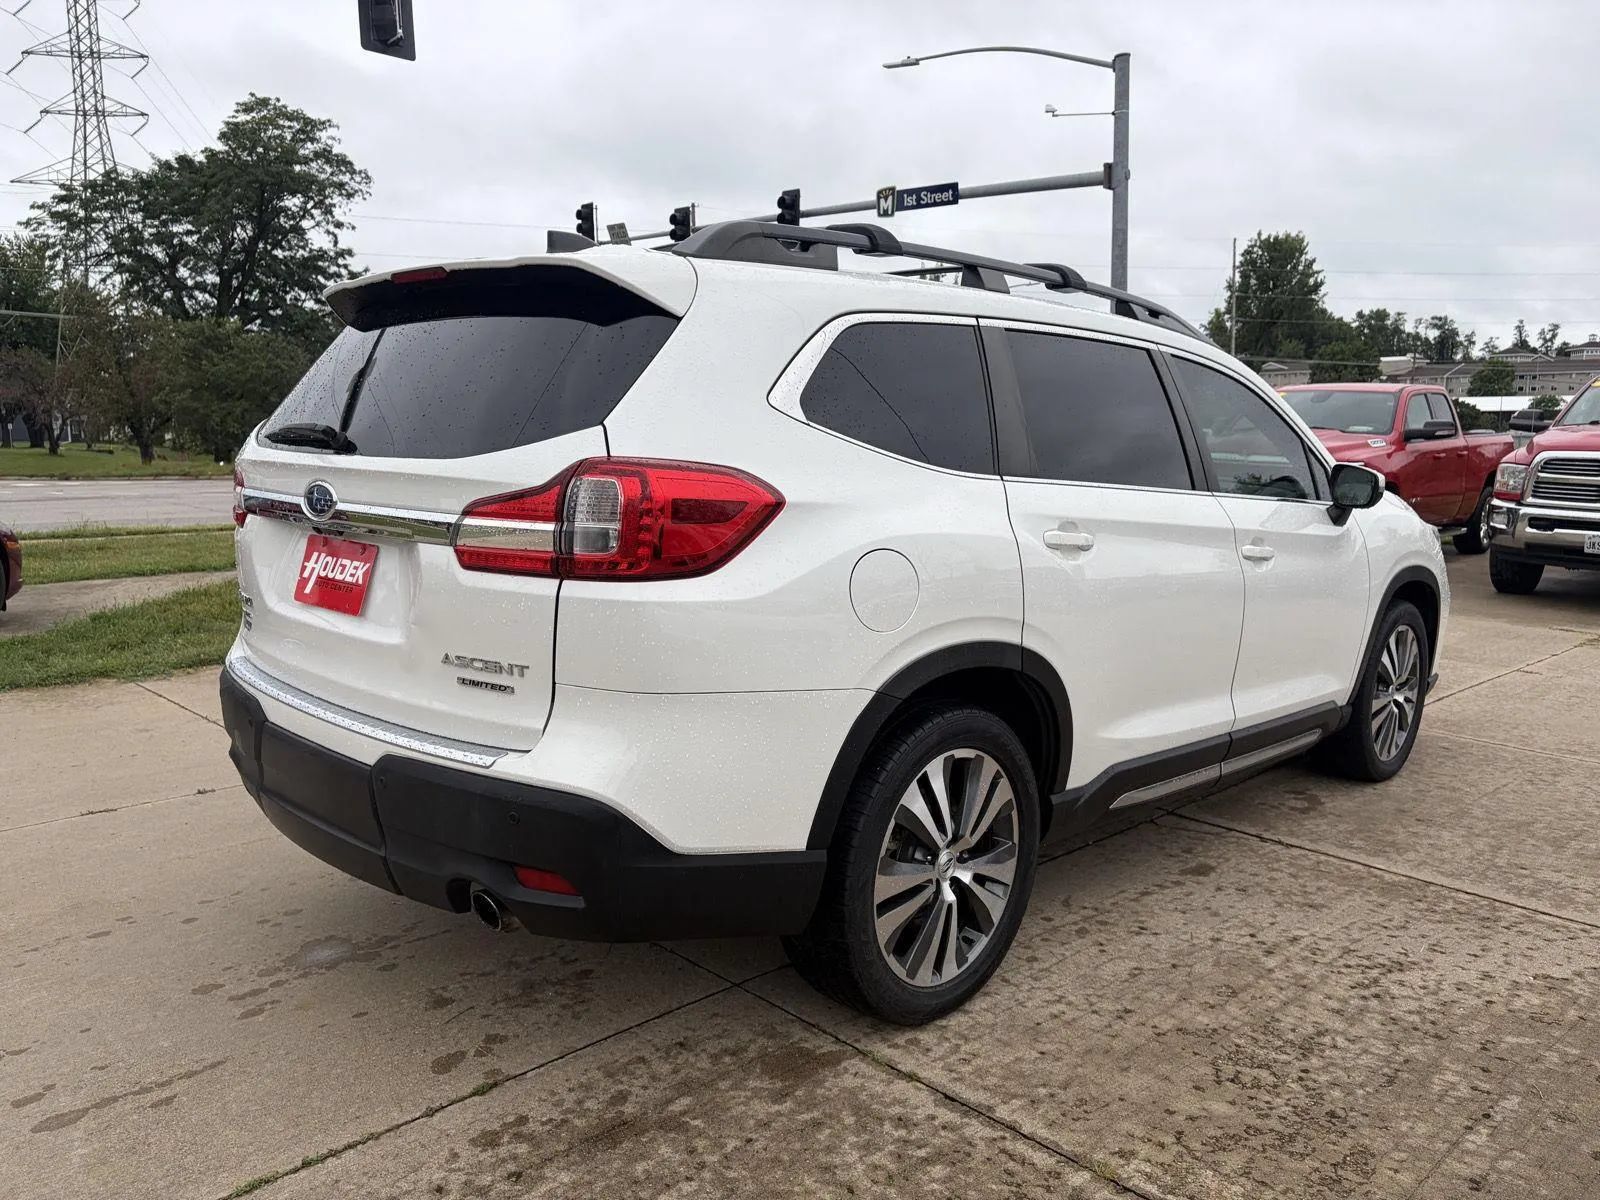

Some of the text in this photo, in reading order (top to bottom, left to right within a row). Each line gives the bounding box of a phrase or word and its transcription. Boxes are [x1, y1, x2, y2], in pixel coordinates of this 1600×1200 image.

[880, 195, 893, 215] M
[904, 189, 953, 206] 1st Street
[302, 551, 371, 594] HOUDEK
[330, 582, 354, 593] CENTER
[441, 652, 530, 678] ASCENT
[461, 677, 508, 692] LIMITED
